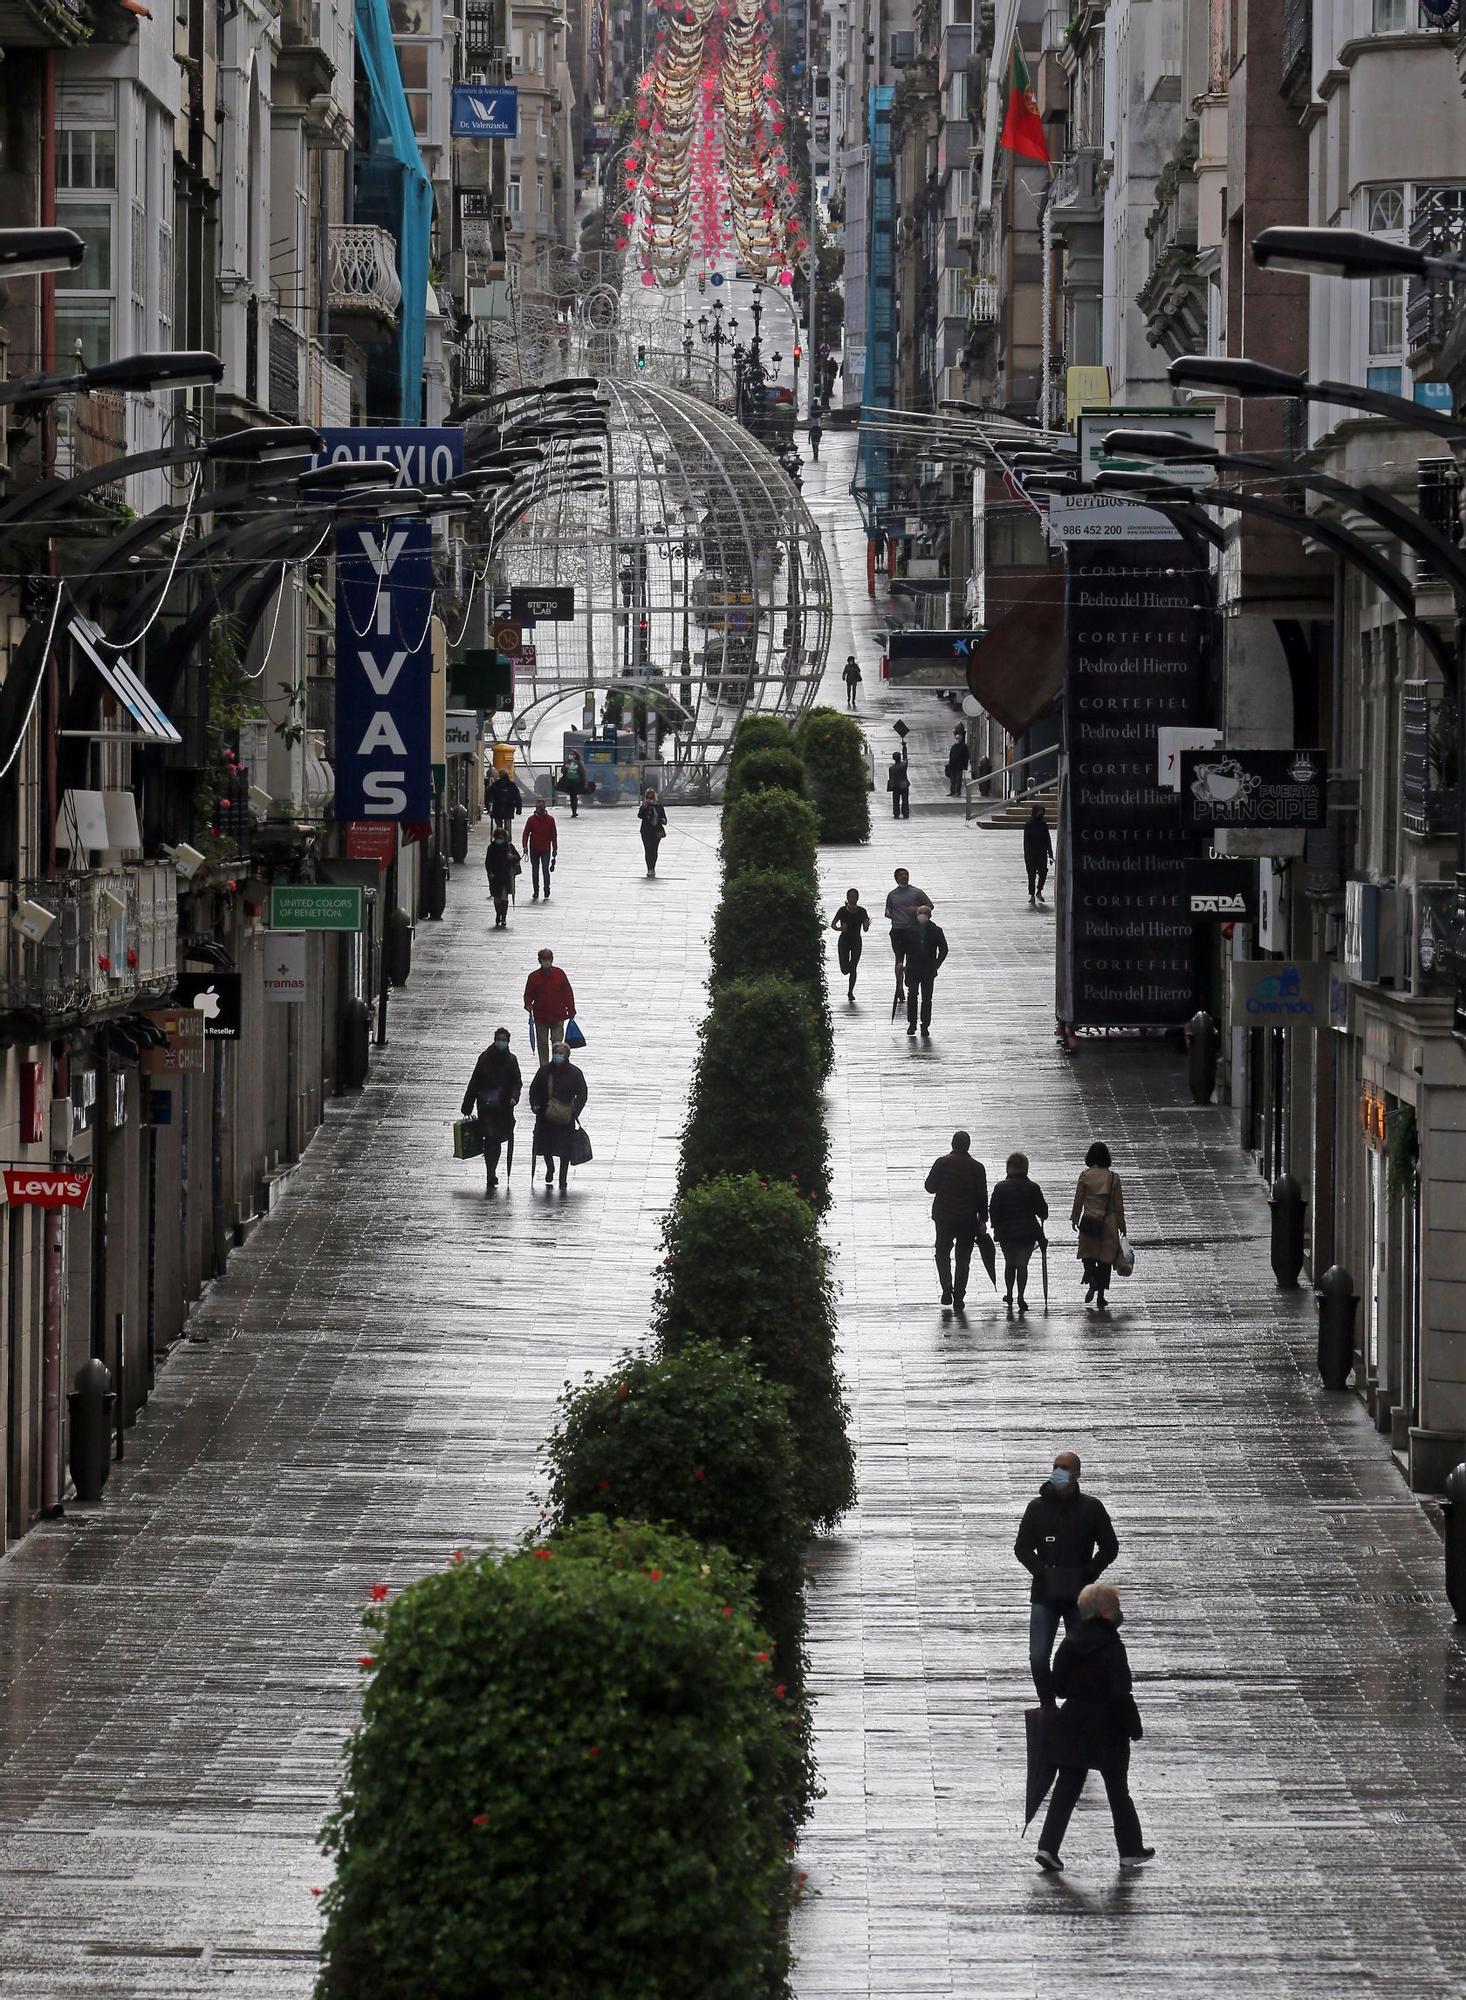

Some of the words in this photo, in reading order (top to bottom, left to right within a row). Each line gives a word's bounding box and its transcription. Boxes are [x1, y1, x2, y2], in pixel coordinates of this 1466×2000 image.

[460, 121, 470, 129] Dr.
[472, 121, 508, 129] Valenzuela
[1063, 525, 1081, 535] 986
[1083, 525, 1101, 535] 452
[1103, 525, 1122, 535] 200
[1079, 566, 1188, 577] CORTEFIL
[1080, 591, 1118, 607] Pedro
[1120, 591, 1139, 607] del
[1143, 591, 1189, 607] Hierro
[1078, 632, 1188, 643] CORTEFIEL
[1079, 657, 1118, 673] Pedro
[1120, 657, 1139, 673] del
[1143, 657, 1188, 673] Hierro
[356, 532, 409, 815] VIVAS
[1079, 698, 1190, 709] CORTEFIEL
[1080, 723, 1119, 739] Pedro
[1121, 723, 1140, 739] del
[1079, 763, 1153, 775] CORTEF
[1080, 789, 1119, 805] Pedro
[1121, 789, 1140, 805] del
[1144, 789, 1180, 805] Hierr
[1259, 785, 1320, 798] PUERTA
[1193, 801, 1319, 821] PRINCIPE
[280, 899, 314, 907] UNITED
[315, 899, 352, 907] COLORS
[1083, 895, 1180, 907] CORTEFIE
[280, 909, 293, 917] OF
[1085, 920, 1123, 937] Pedro
[1126, 920, 1144, 937] del
[1148, 920, 1192, 937] Hierro
[1083, 959, 1192, 971] CORTEFIEL
[1084, 984, 1123, 1001] Pedro
[1125, 984, 1144, 1001] del
[1147, 984, 1192, 1001] Hierro
[209, 1027, 235, 1035] Reseller
